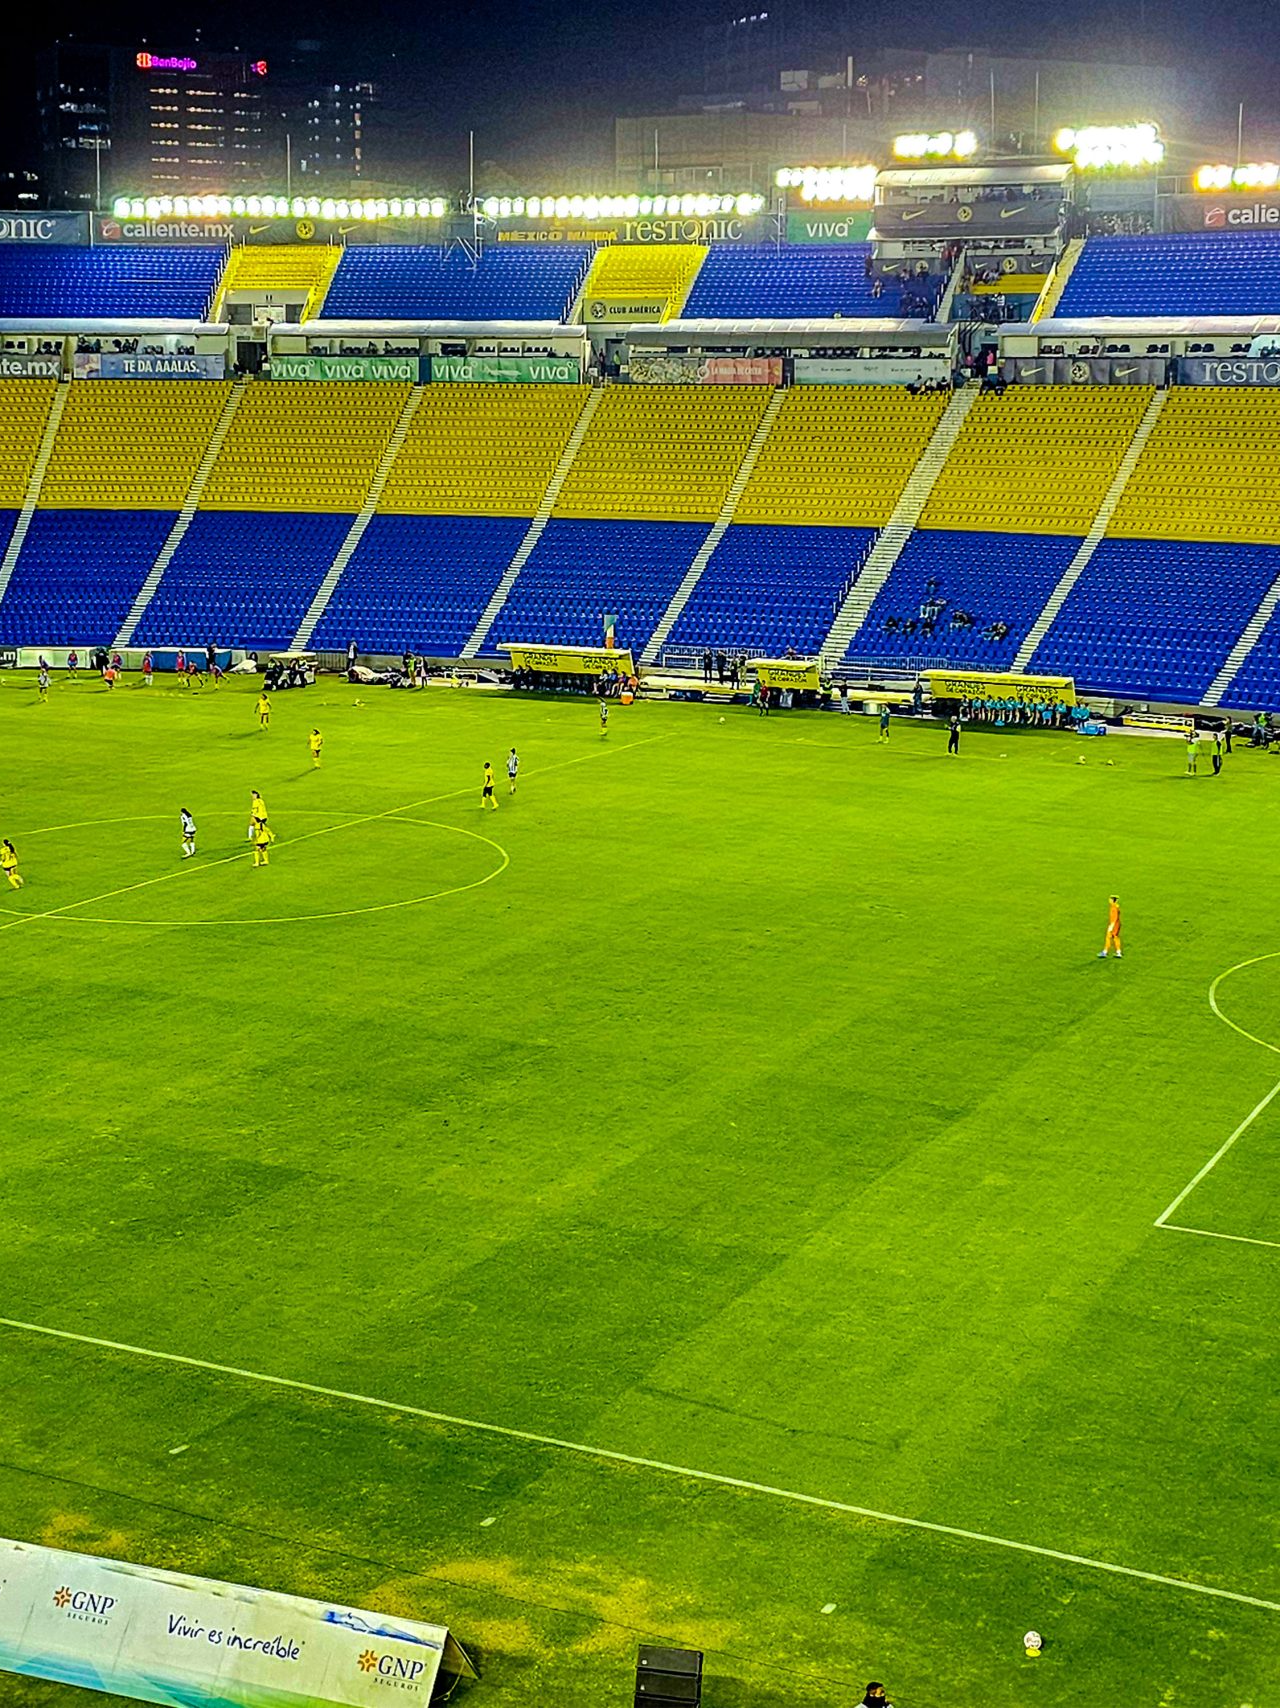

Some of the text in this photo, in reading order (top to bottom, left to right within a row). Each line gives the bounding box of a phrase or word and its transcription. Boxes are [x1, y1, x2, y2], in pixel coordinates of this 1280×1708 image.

[123, 220, 235, 238] caliente.mx
[609, 305, 661, 314] CLUB AMÉRICA
[123, 360, 200, 373] TE DA AAALAS.
[71, 1590, 117, 1616] GNP
[168, 1613, 300, 1661] Vivir es increíble
[378, 1654, 425, 1682] GNP
[373, 1675, 421, 1693] SEGUROS
